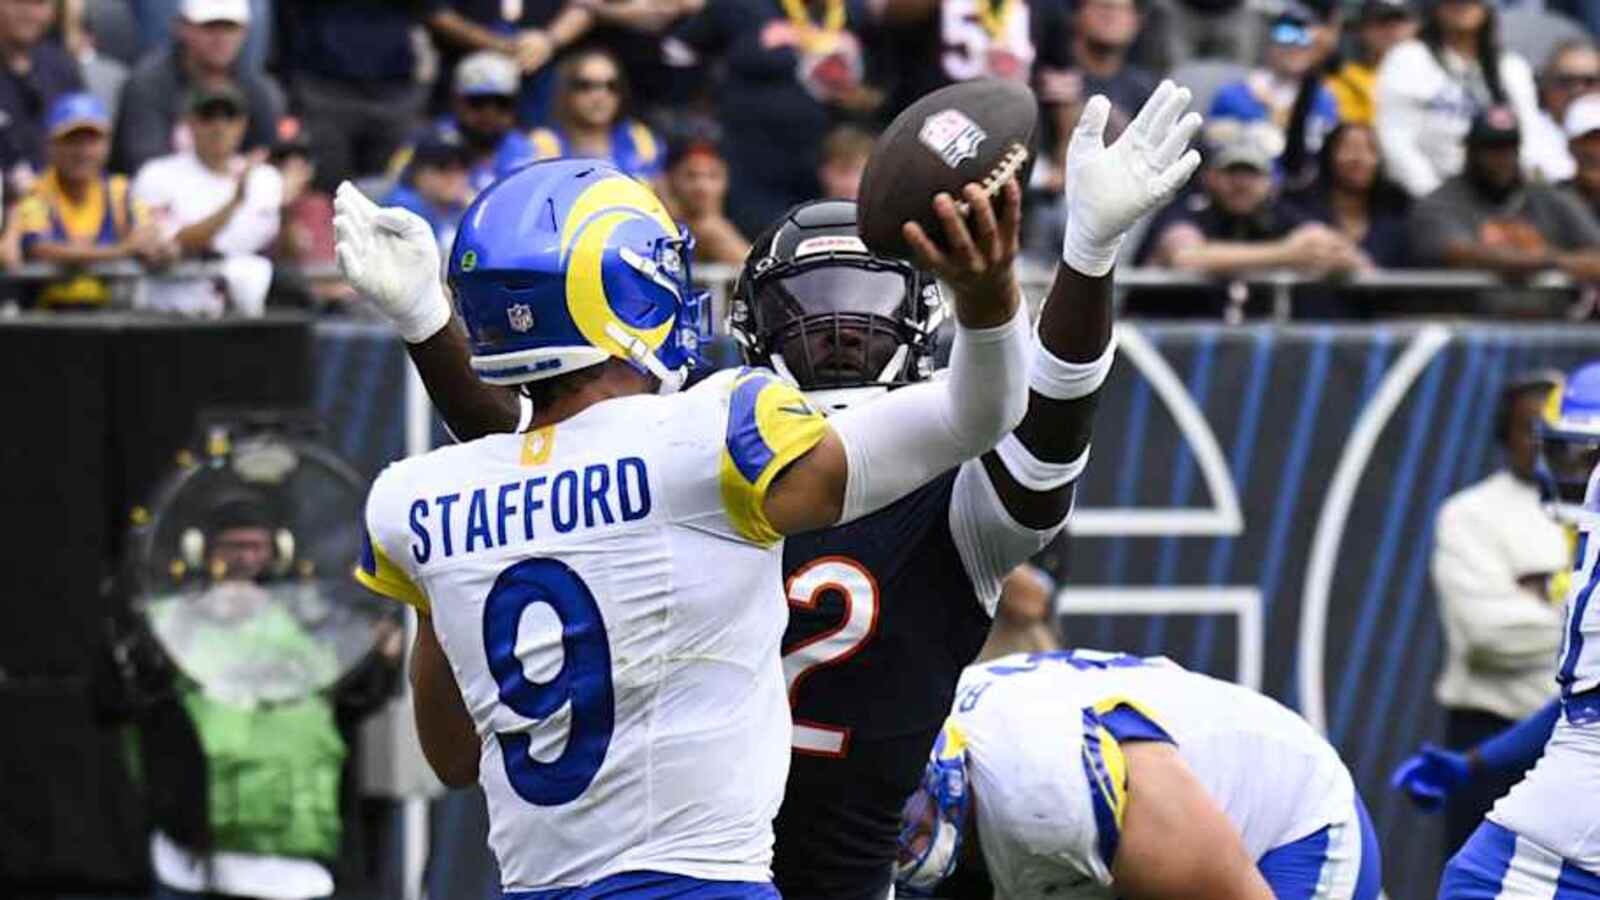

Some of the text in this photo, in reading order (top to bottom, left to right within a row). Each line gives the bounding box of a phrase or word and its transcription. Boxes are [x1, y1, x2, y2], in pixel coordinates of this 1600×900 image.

[409, 456, 652, 565] STAFFORD
[483, 557, 615, 806] 9
[782, 555, 879, 759] 2
